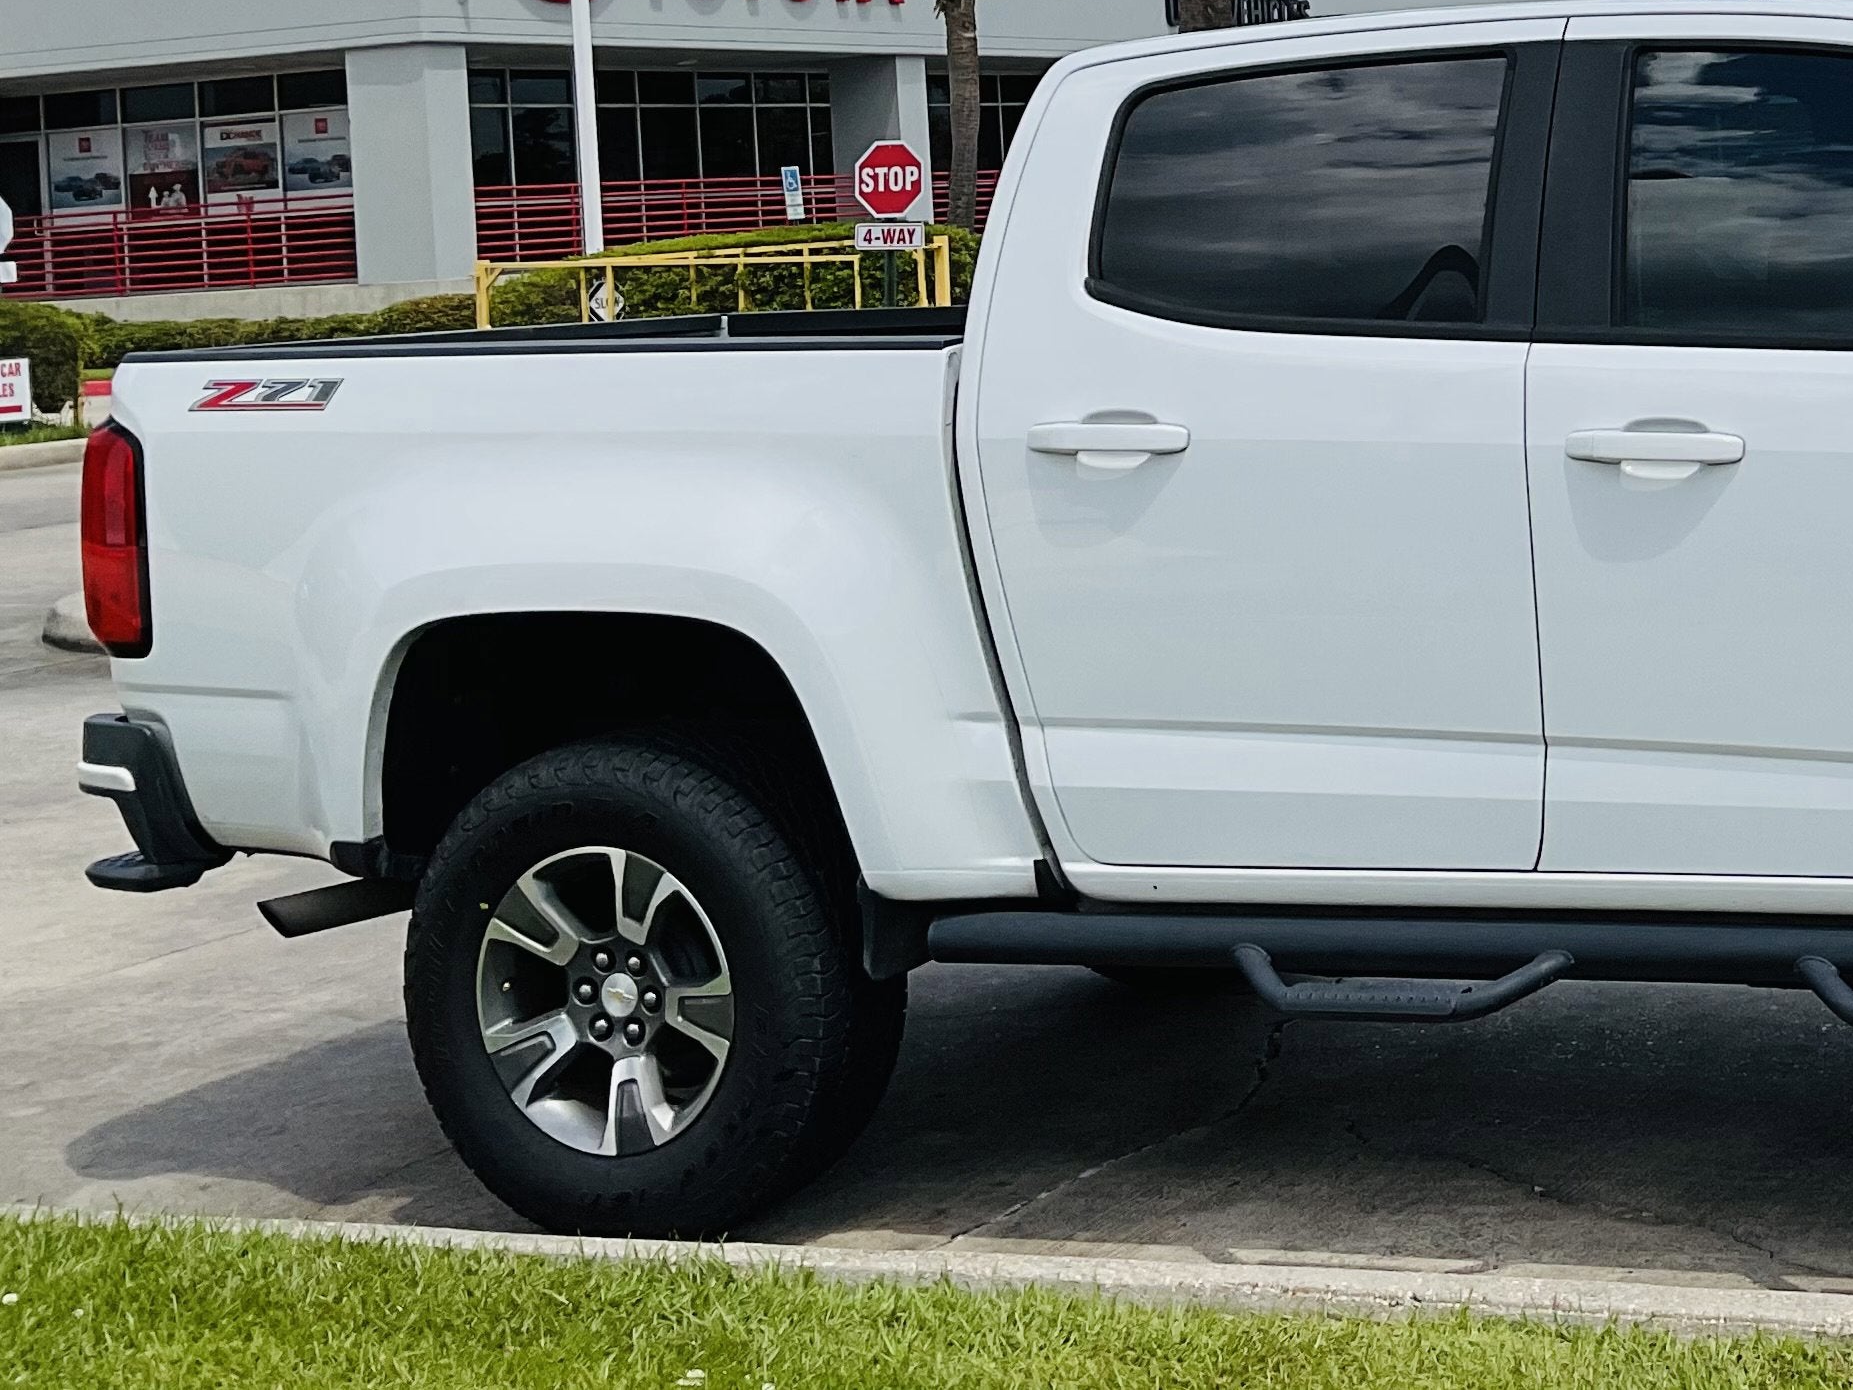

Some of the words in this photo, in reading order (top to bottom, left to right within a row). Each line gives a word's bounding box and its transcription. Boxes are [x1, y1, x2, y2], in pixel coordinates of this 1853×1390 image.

[860, 165, 919, 193] STOP
[863, 228, 916, 245] 4-WAY
[594, 296, 621, 310] SLW
[1, 362, 21, 378] CAR
[188, 378, 345, 411] Z71
